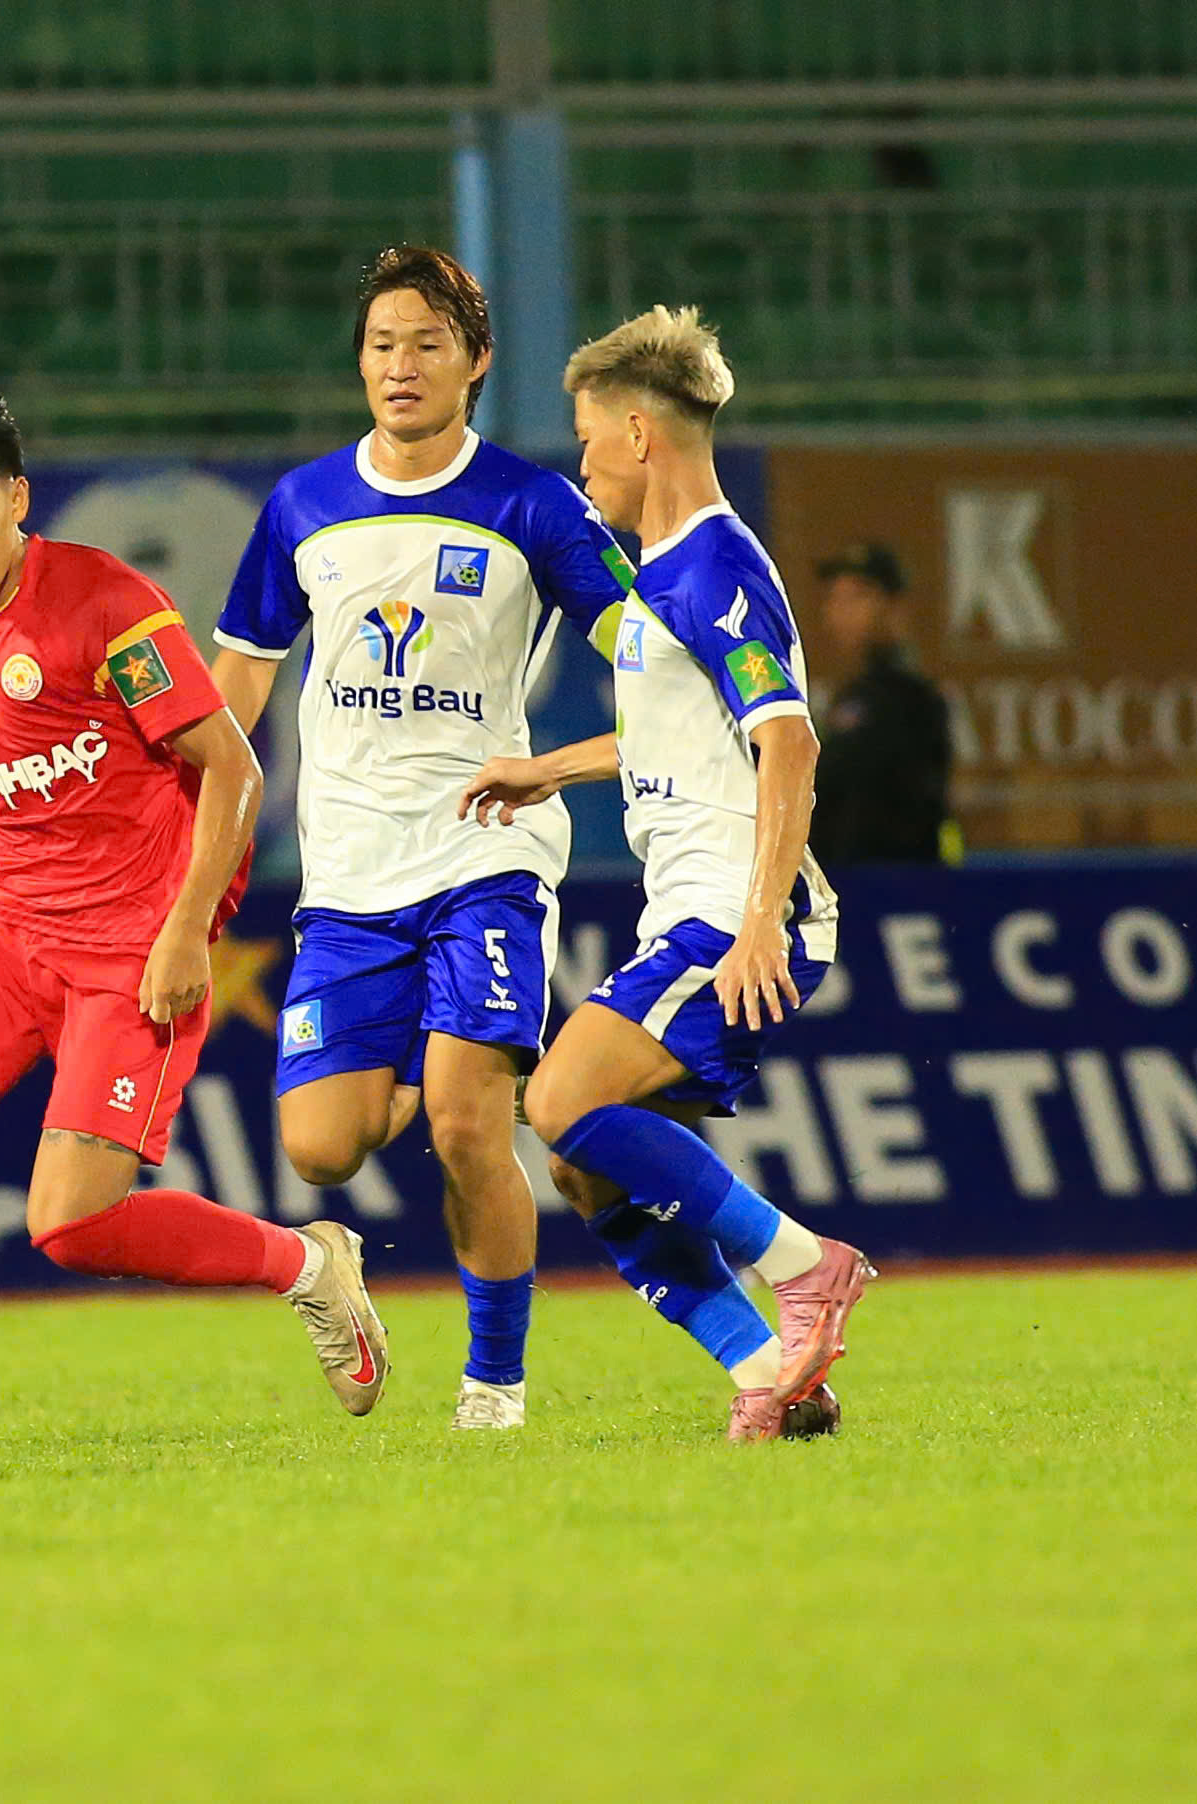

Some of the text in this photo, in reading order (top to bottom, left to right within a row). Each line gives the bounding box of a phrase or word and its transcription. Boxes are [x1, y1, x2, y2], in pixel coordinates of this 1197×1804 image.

[326, 679, 484, 721] Yang Bay
[484, 929, 510, 977] 5
